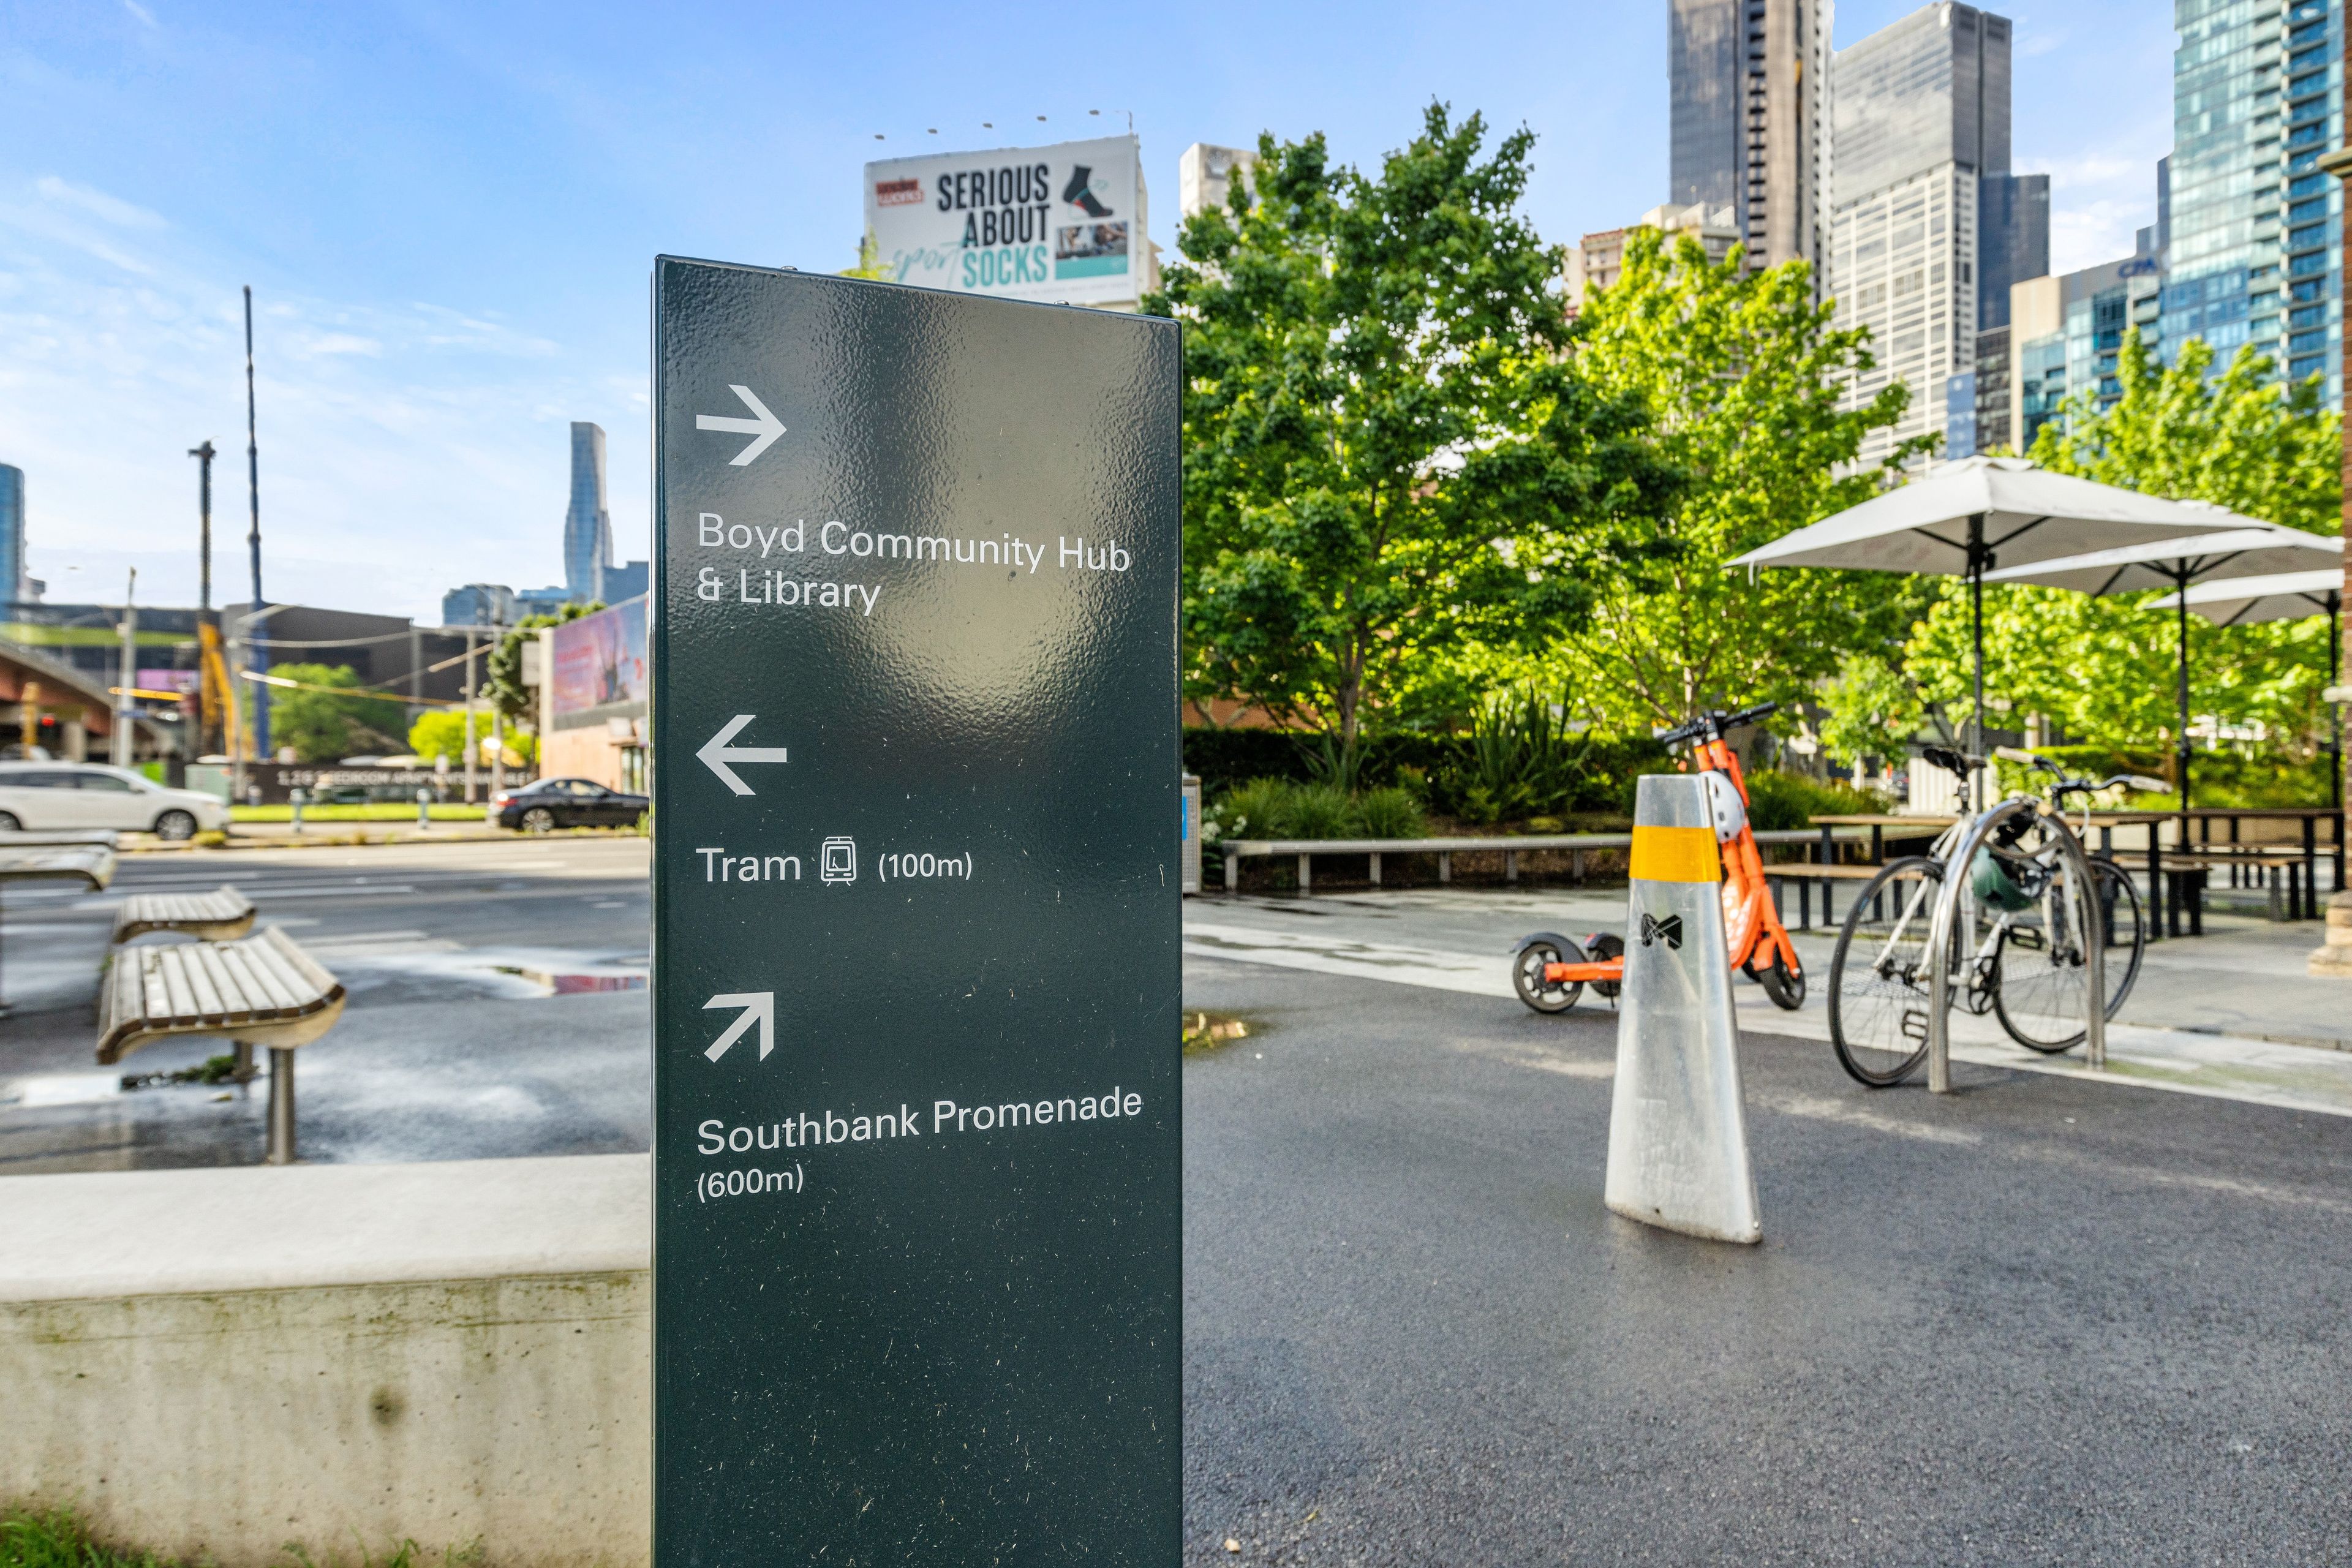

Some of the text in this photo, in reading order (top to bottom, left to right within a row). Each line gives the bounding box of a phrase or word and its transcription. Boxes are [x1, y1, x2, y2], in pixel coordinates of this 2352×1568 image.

[938, 164, 1049, 211] SERIOUS
[963, 204, 1050, 248] ABOUT
[963, 246, 1047, 288] SOCKS
[698, 512, 1130, 574] Boyd Community Hub
[697, 567, 881, 617] & Library
[696, 848, 972, 883] Tram (100m)
[698, 1086, 1143, 1155] Southbank Promenade
[698, 1163, 804, 1204] (600m)
